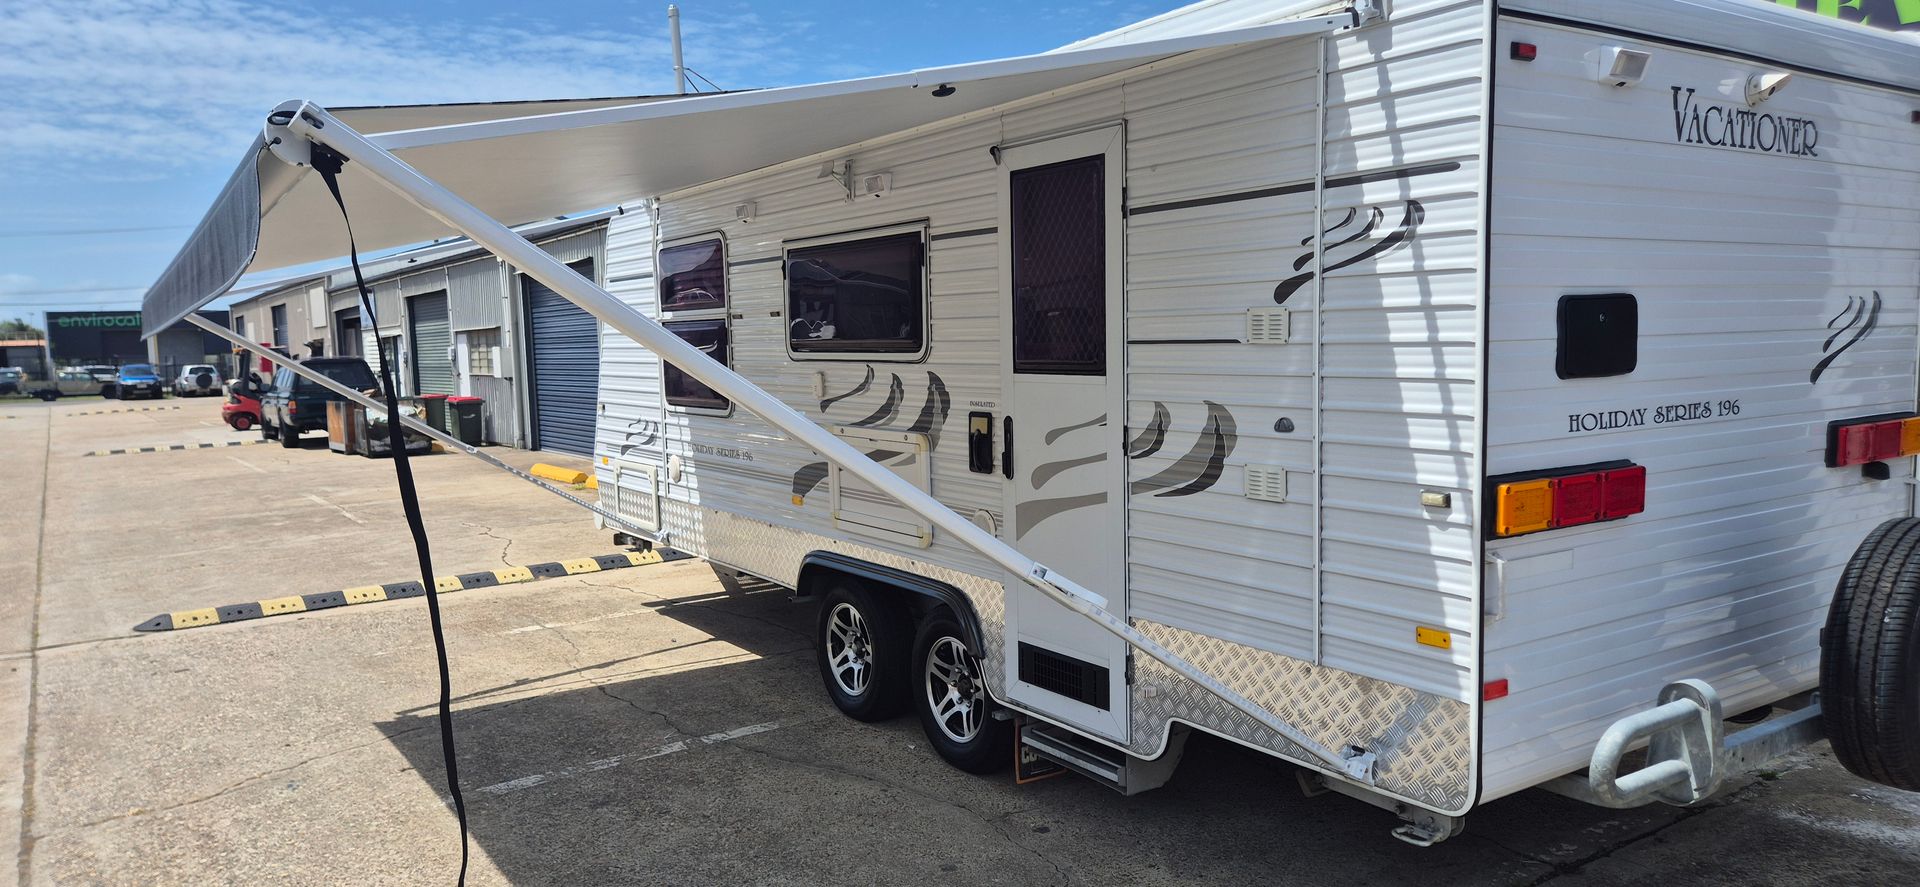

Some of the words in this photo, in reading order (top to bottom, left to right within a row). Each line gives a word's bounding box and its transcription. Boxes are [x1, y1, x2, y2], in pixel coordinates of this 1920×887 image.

[1670, 86, 1818, 157] VACATIONER
[1568, 408, 1647, 433] HOLIDAY
[1653, 401, 1712, 424] SERIES
[1717, 399, 1740, 417] 196
[688, 443, 714, 456] HOLIDAY
[715, 447, 741, 460] SERIES
[742, 451, 754, 462] 196
